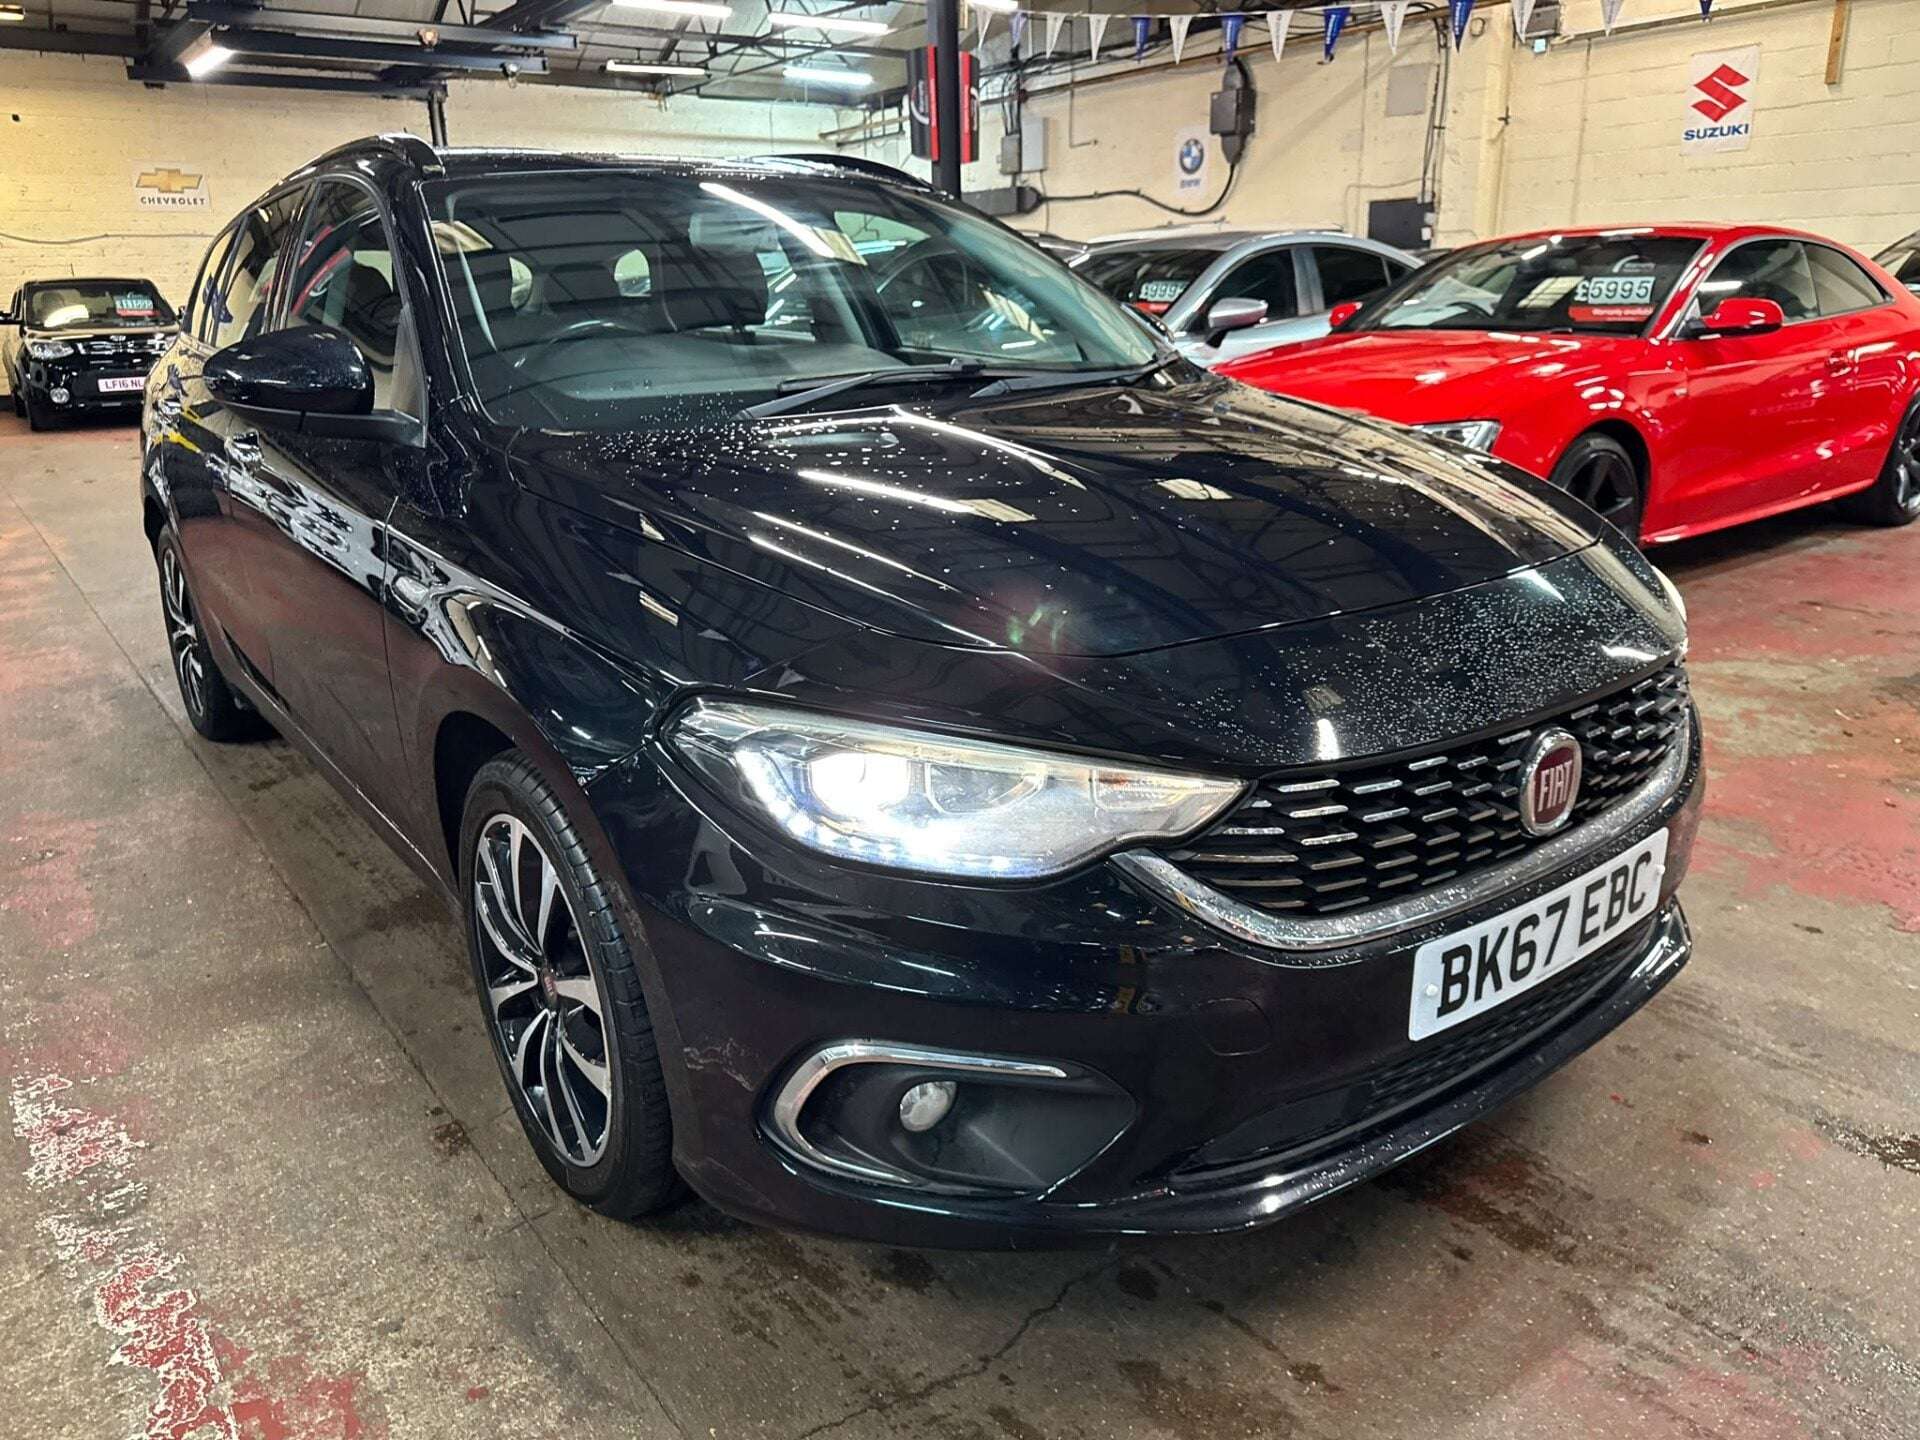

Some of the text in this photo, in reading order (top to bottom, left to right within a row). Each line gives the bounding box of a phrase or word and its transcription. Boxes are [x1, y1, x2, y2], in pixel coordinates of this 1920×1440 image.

[1683, 123, 1749, 140] SUZUKI
[140, 196, 206, 206] CHEVROLET
[1574, 279, 1651, 302] £5995
[1538, 760, 1574, 812] FIAT
[1436, 851, 1652, 1018] BK67 EBC
